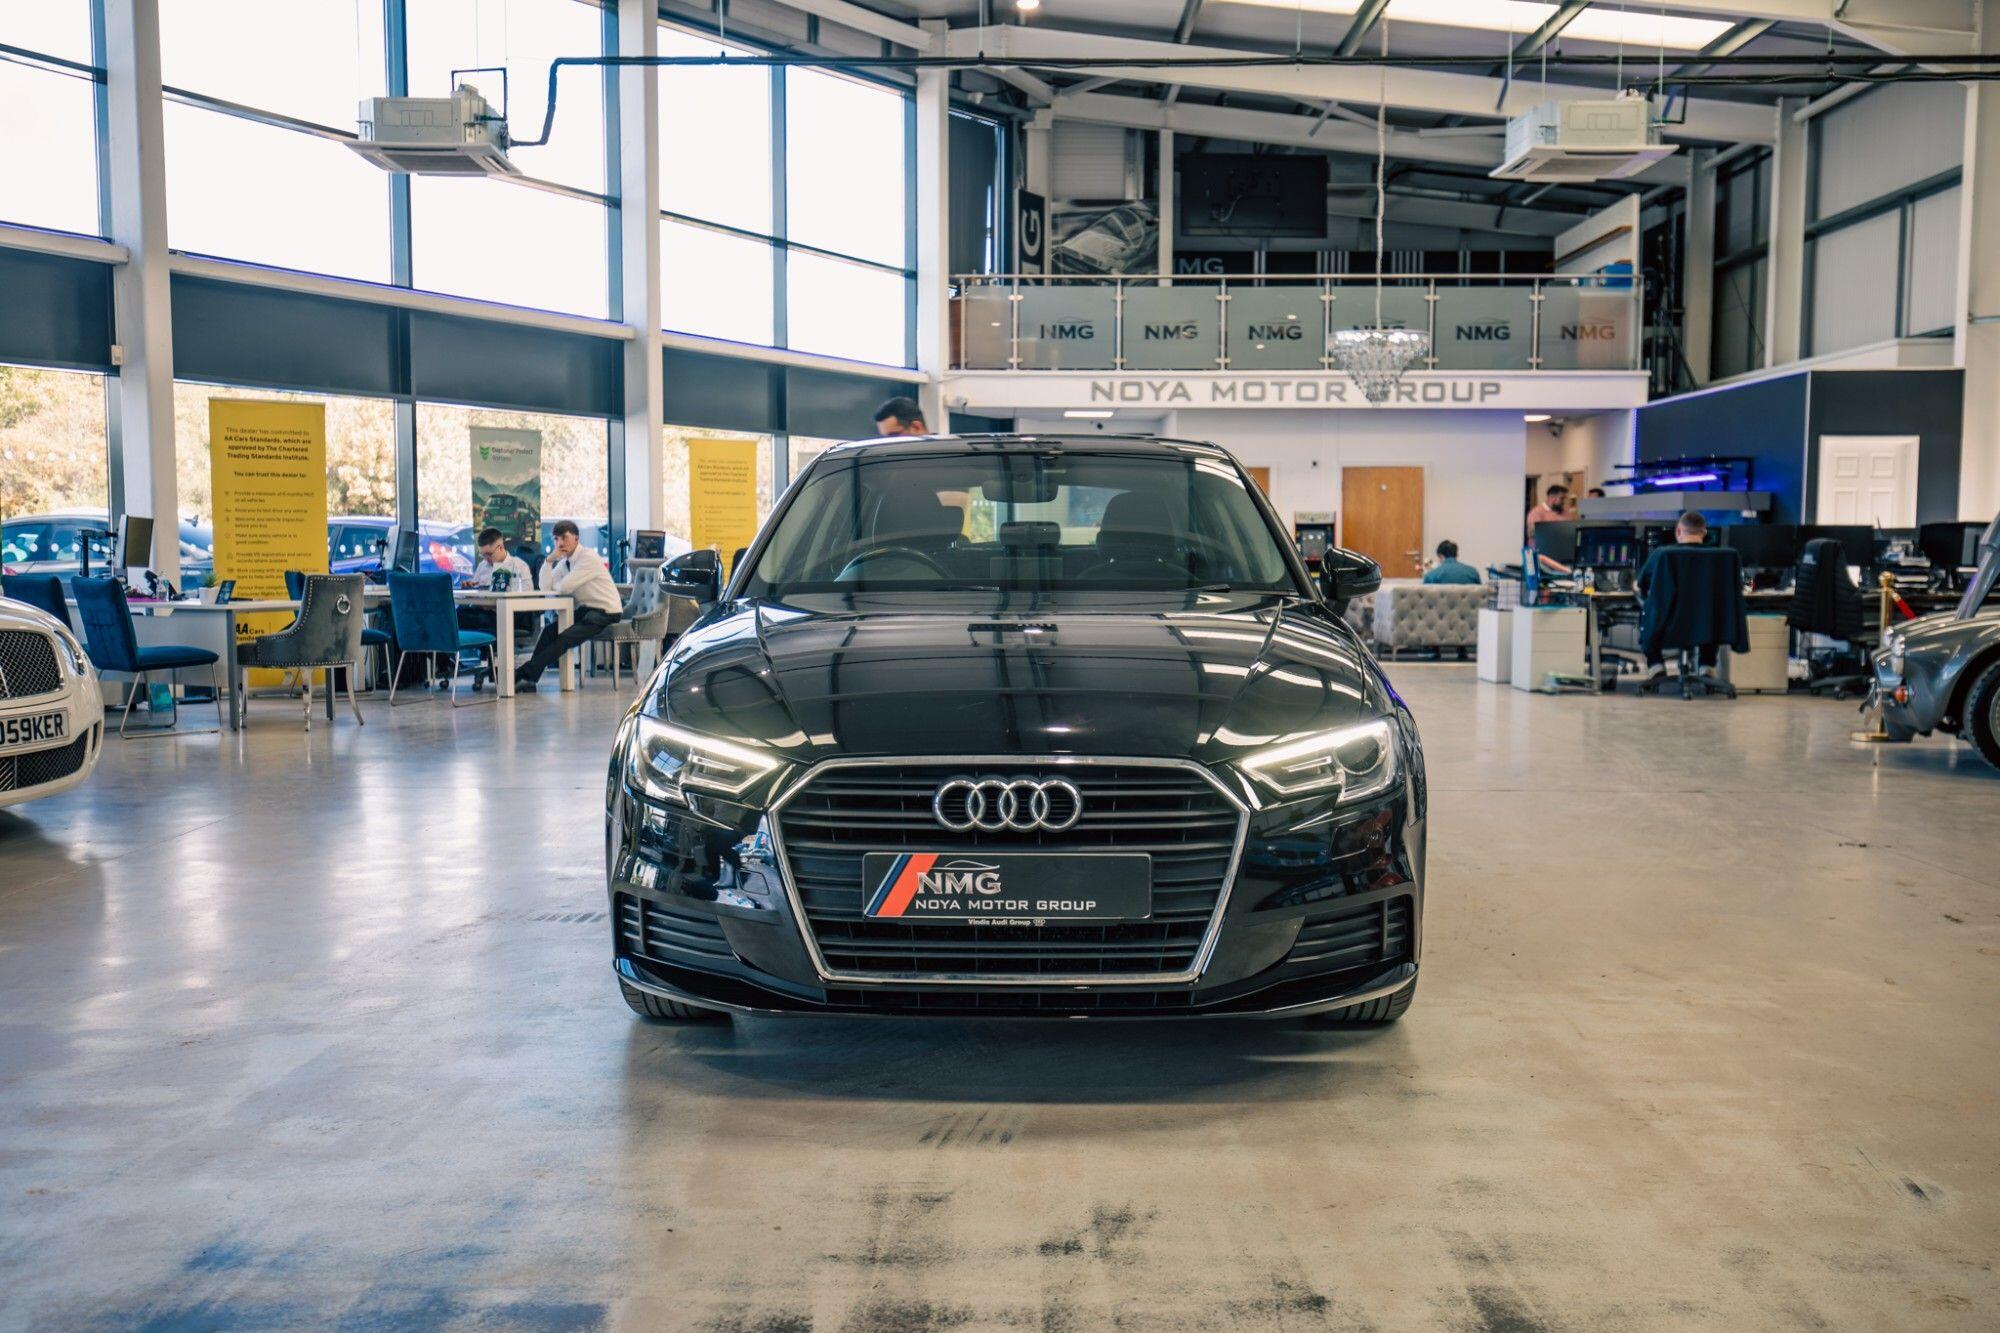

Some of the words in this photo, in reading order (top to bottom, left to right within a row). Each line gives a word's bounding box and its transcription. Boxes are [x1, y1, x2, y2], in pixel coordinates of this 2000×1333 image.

[1172, 257, 1224, 275] MG
[1040, 325, 1094, 339] NMG
[1145, 325, 1198, 339] NMG
[1249, 325, 1302, 340] NMG
[1456, 325, 1511, 341] NMG
[1561, 325, 1616, 341] NMG
[1091, 381, 1192, 401] NOYA
[1212, 381, 1347, 401] MOTOR
[1387, 382, 1501, 403] ROUP
[917, 872, 1001, 895] NMG
[915, 899, 961, 910] NOYA
[968, 899, 1029, 910] MOTOR
[1036, 900, 1097, 911] GROUP
[1009, 919, 1031, 927] Group
